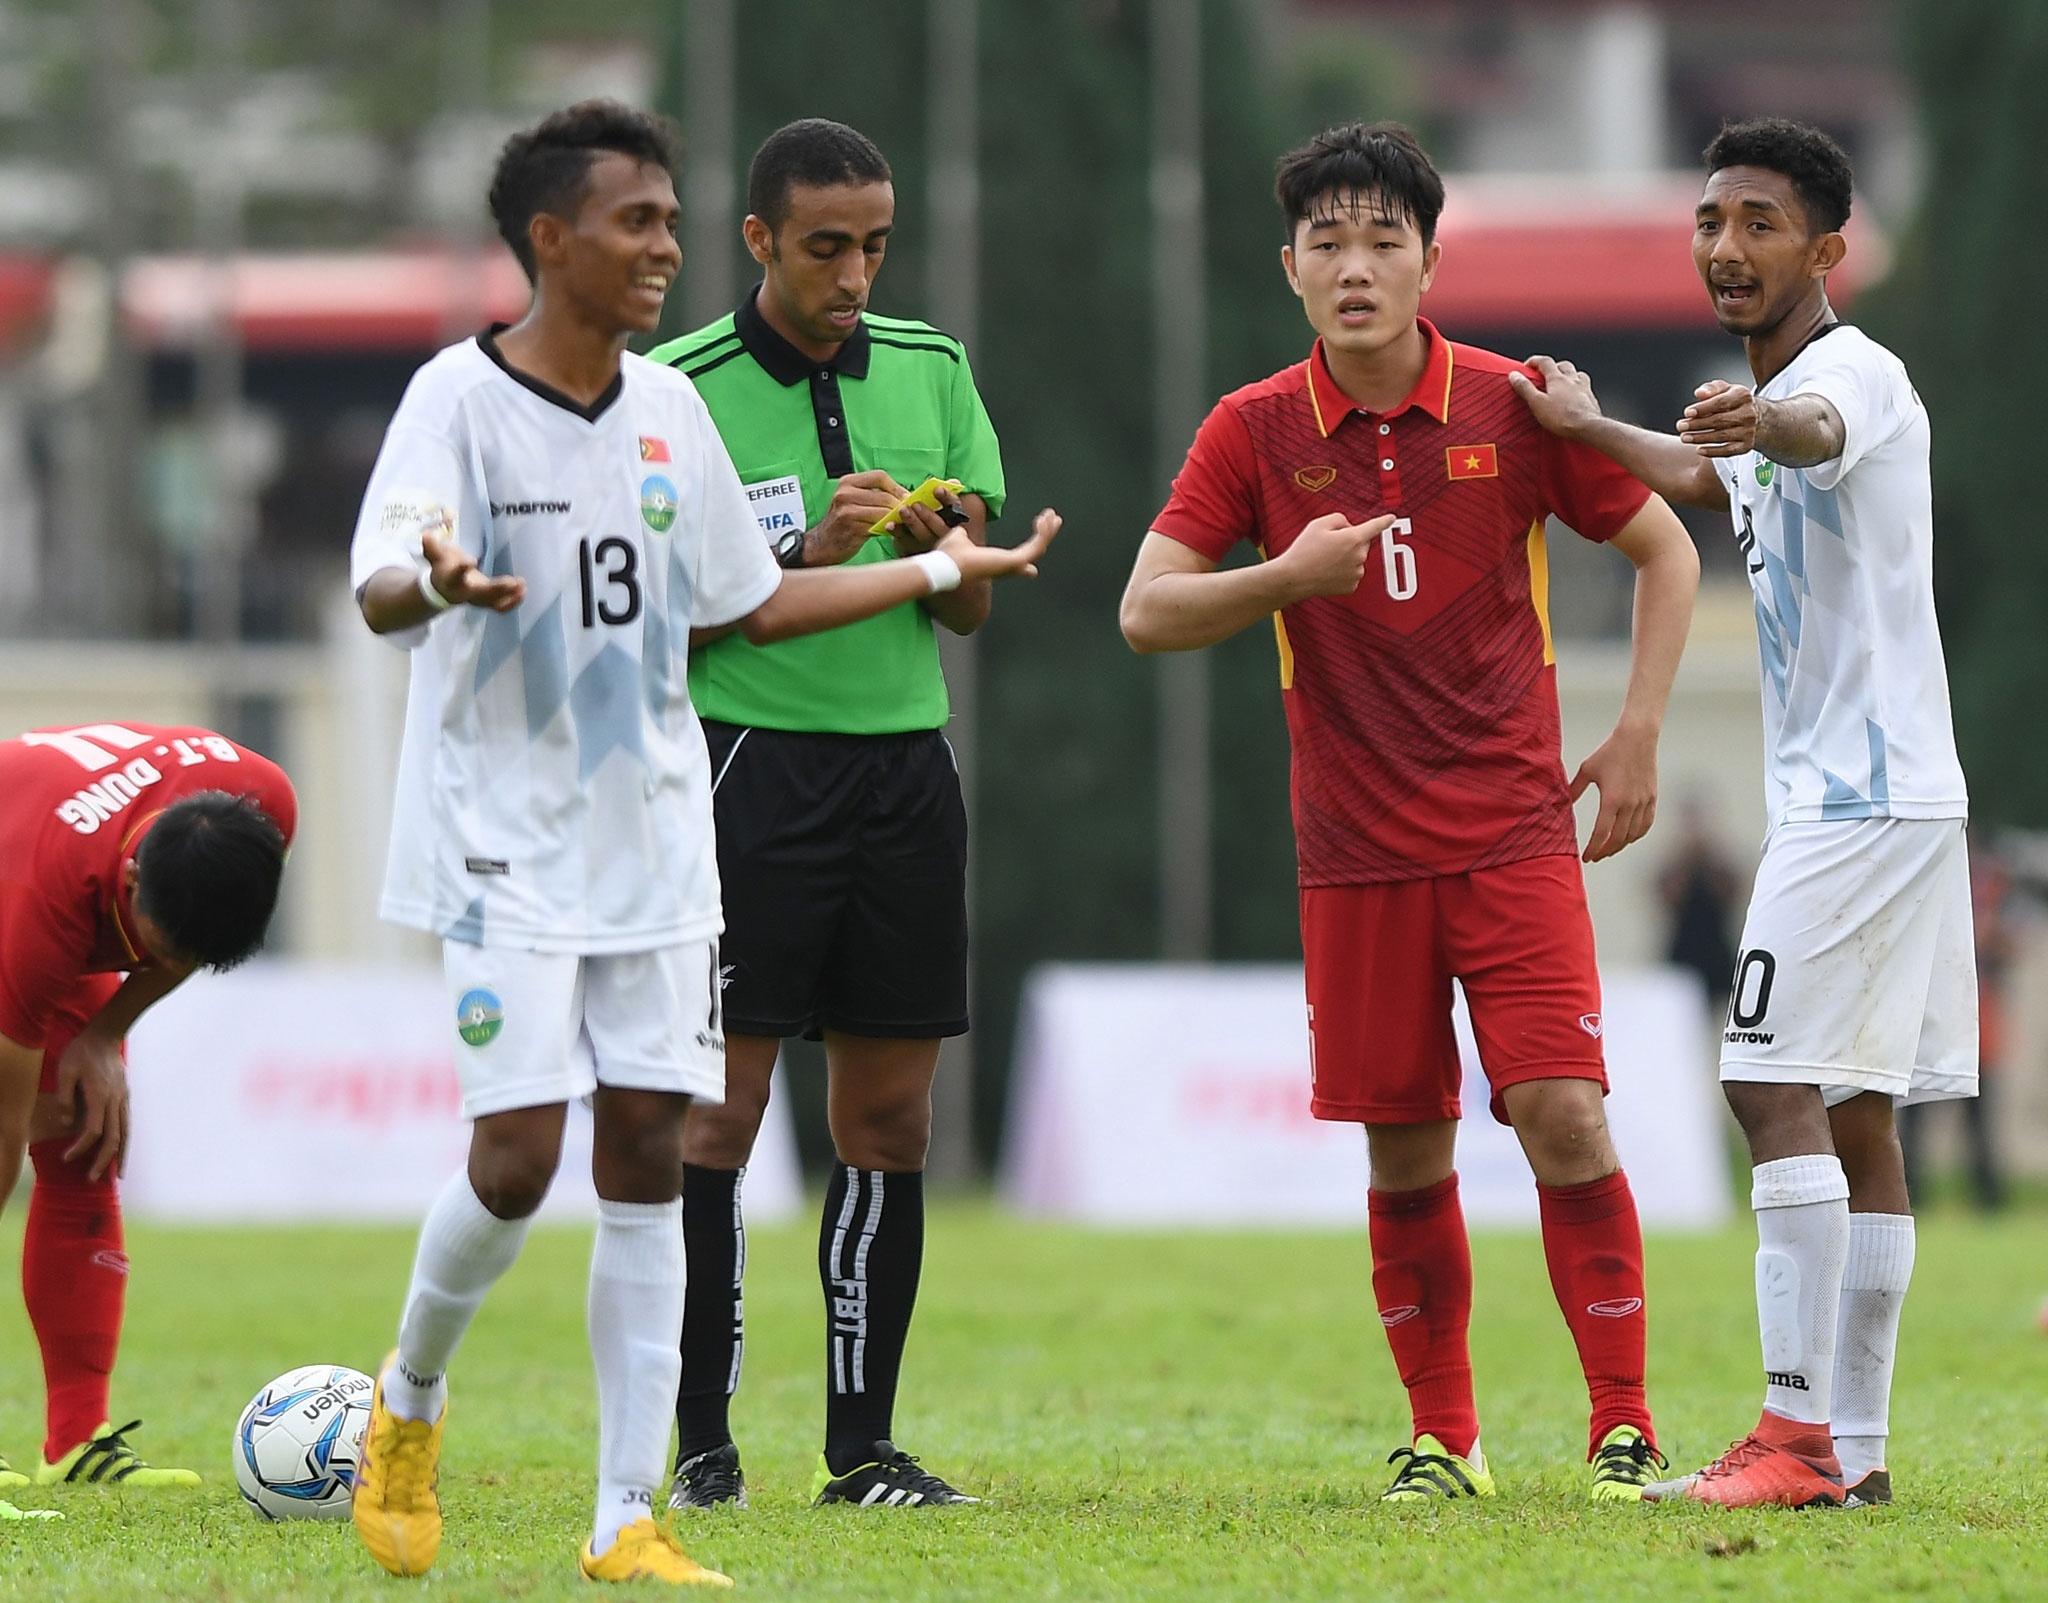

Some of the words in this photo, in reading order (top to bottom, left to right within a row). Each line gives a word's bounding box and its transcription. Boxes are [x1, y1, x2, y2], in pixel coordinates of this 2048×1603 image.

[746, 482, 797, 501] EFEREE
[579, 536, 642, 628] 13
[1381, 518, 1418, 600] 6
[832, 1279, 867, 1338] FBT
[303, 1379, 370, 1419] molten
[1767, 1371, 1809, 1391] ma
